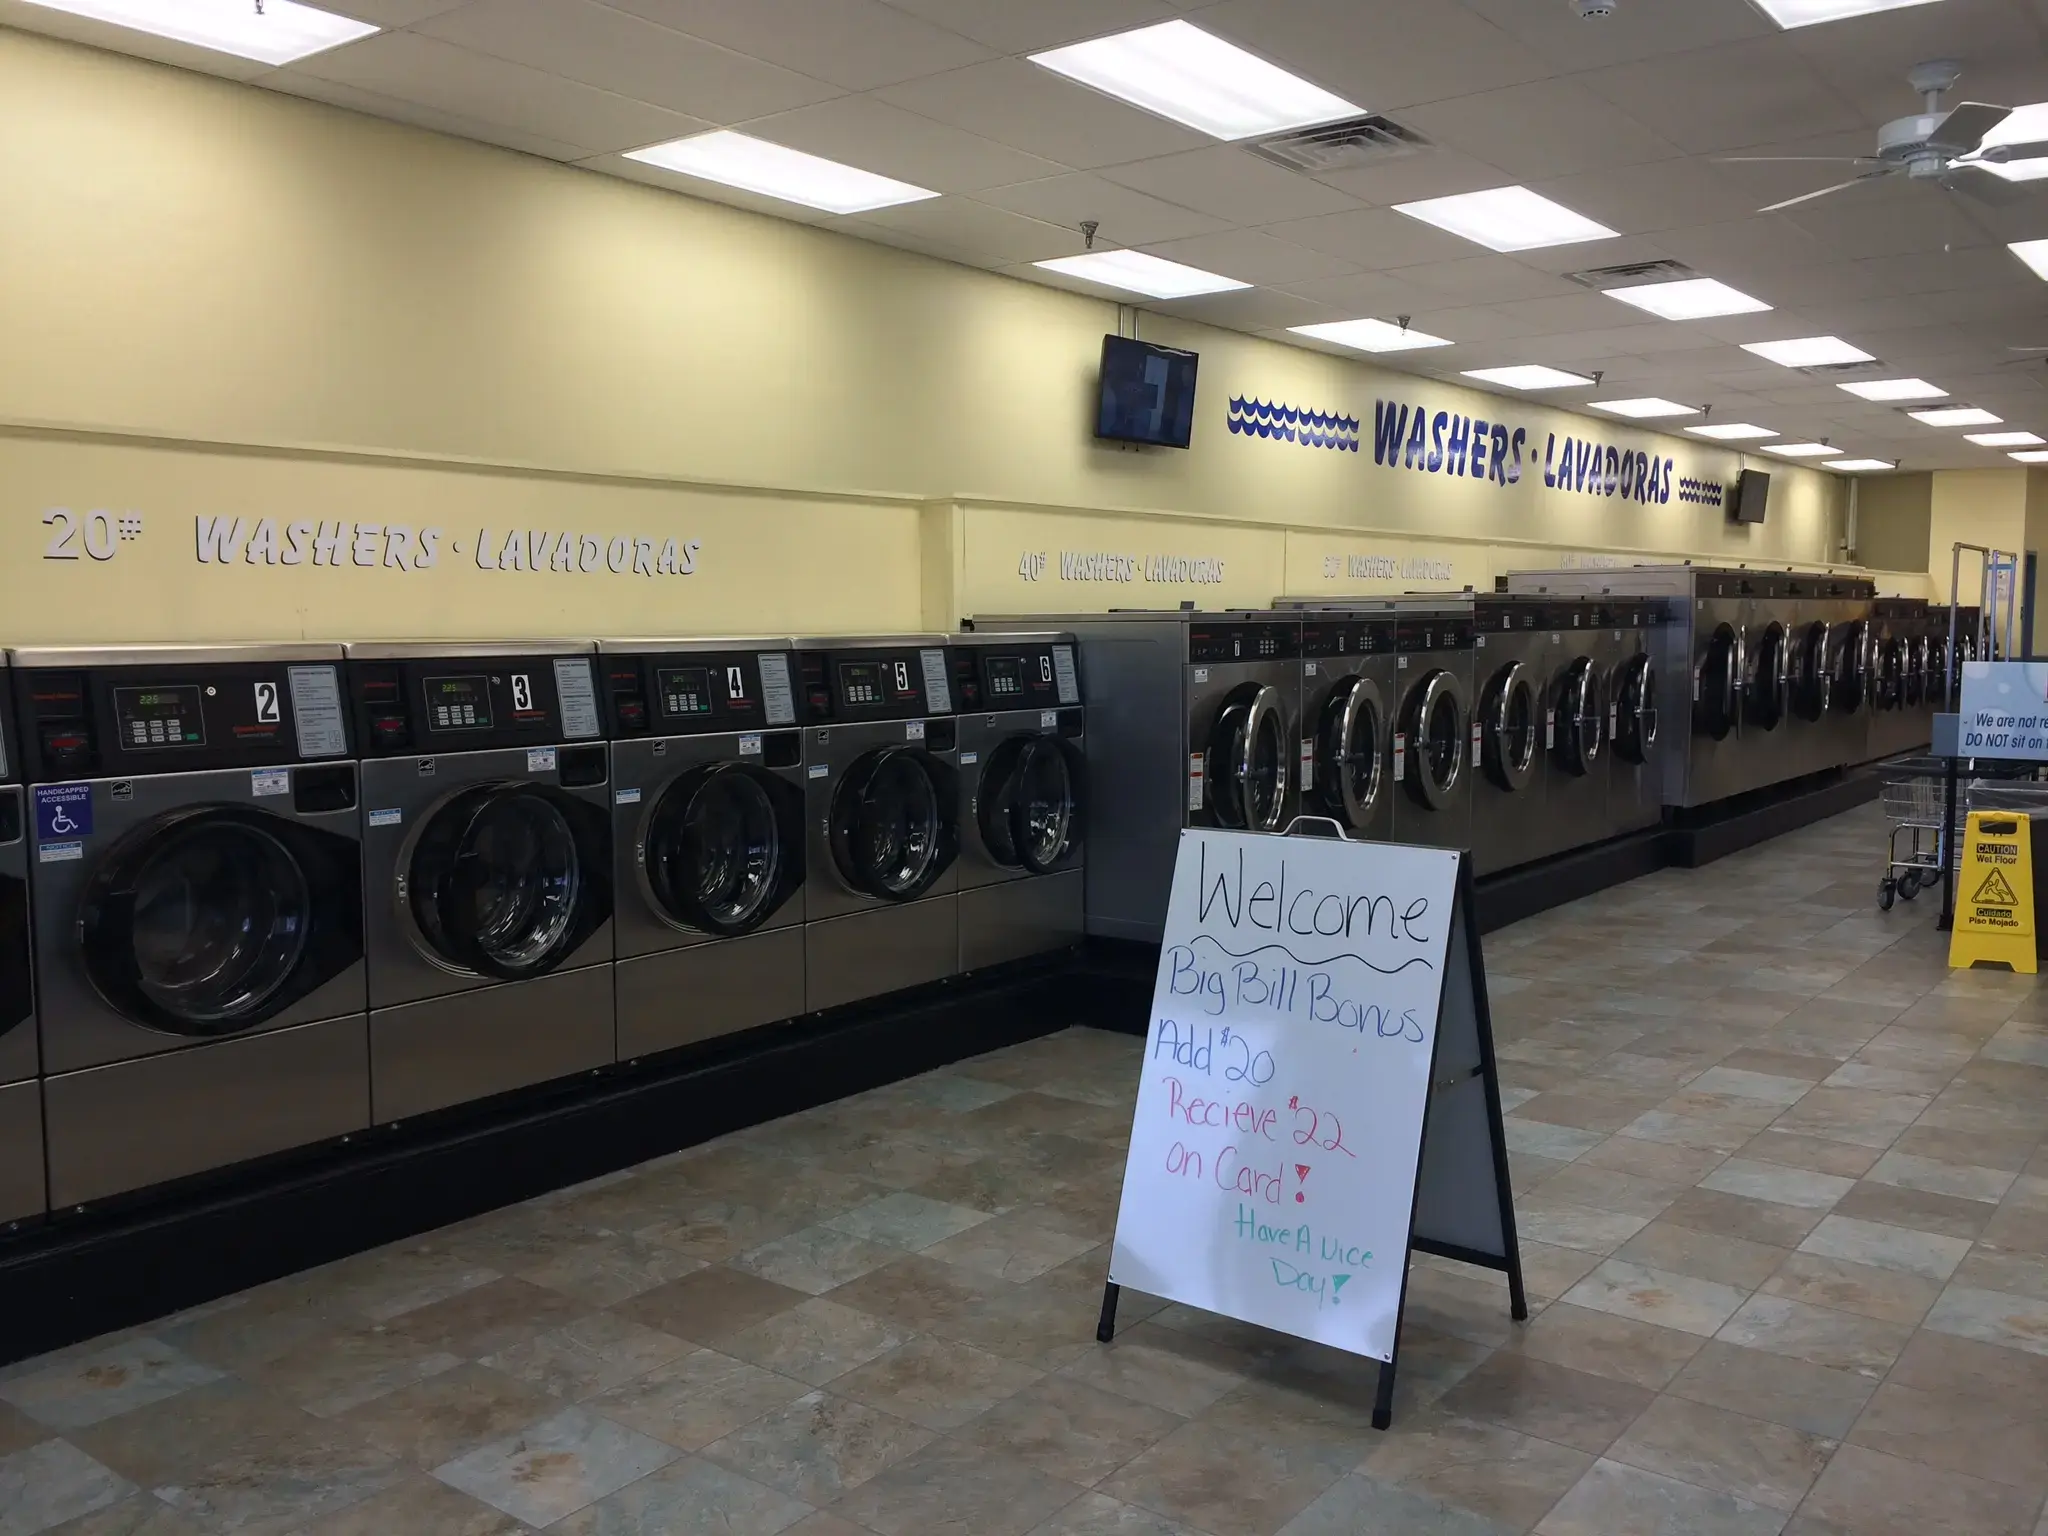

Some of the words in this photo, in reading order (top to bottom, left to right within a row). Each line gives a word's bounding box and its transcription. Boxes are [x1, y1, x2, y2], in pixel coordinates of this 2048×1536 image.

[1374, 398, 1525, 488] WASHERS
[1544, 432, 1673, 505] LAVADORAS
[41, 506, 142, 562] 20#
[195, 514, 442, 572] WASHERS
[475, 527, 701, 577] LAVADORAS
[1018, 550, 1046, 581] 40#
[1060, 550, 1135, 584] WASHERS
[1145, 553, 1225, 585] LAVADORAS
[1348, 554, 1396, 580] WASHERS
[896, 663, 906, 689] 5
[1041, 657, 1050, 680] 6
[514, 676, 529, 709] 3
[730, 668, 741, 697] 4
[258, 683, 278, 720] 2
[1976, 713, 1994, 727] We
[1996, 716, 2015, 728] are
[2018, 715, 2037, 729] not
[1965, 733, 1983, 747] DO
[1985, 733, 2010, 748] NOT
[2010, 735, 2026, 748] sit
[2028, 737, 2043, 749] on
[37, 786, 89, 797] HANDICAPPED
[41, 793, 87, 804] ACCESSIBLE
[1976, 854, 1993, 864] Wet
[1994, 855, 2017, 865] Floor
[1977, 844, 2017, 855] CAUTION
[1199, 841, 1429, 942] Welcome
[1968, 916, 1987, 925] Piso
[1988, 918, 2019, 928] Mojado
[1977, 908, 2012, 918] Cuidado
[1168, 945, 1226, 1016] Big
[1231, 961, 1297, 1012] Bill
[1307, 972, 1425, 1043] Bonus
[1154, 1018, 1213, 1076] Add
[1162, 1076, 1277, 1142] Recieve
[1234, 1203, 1291, 1245] Have
[1296, 1224, 1311, 1255] A
